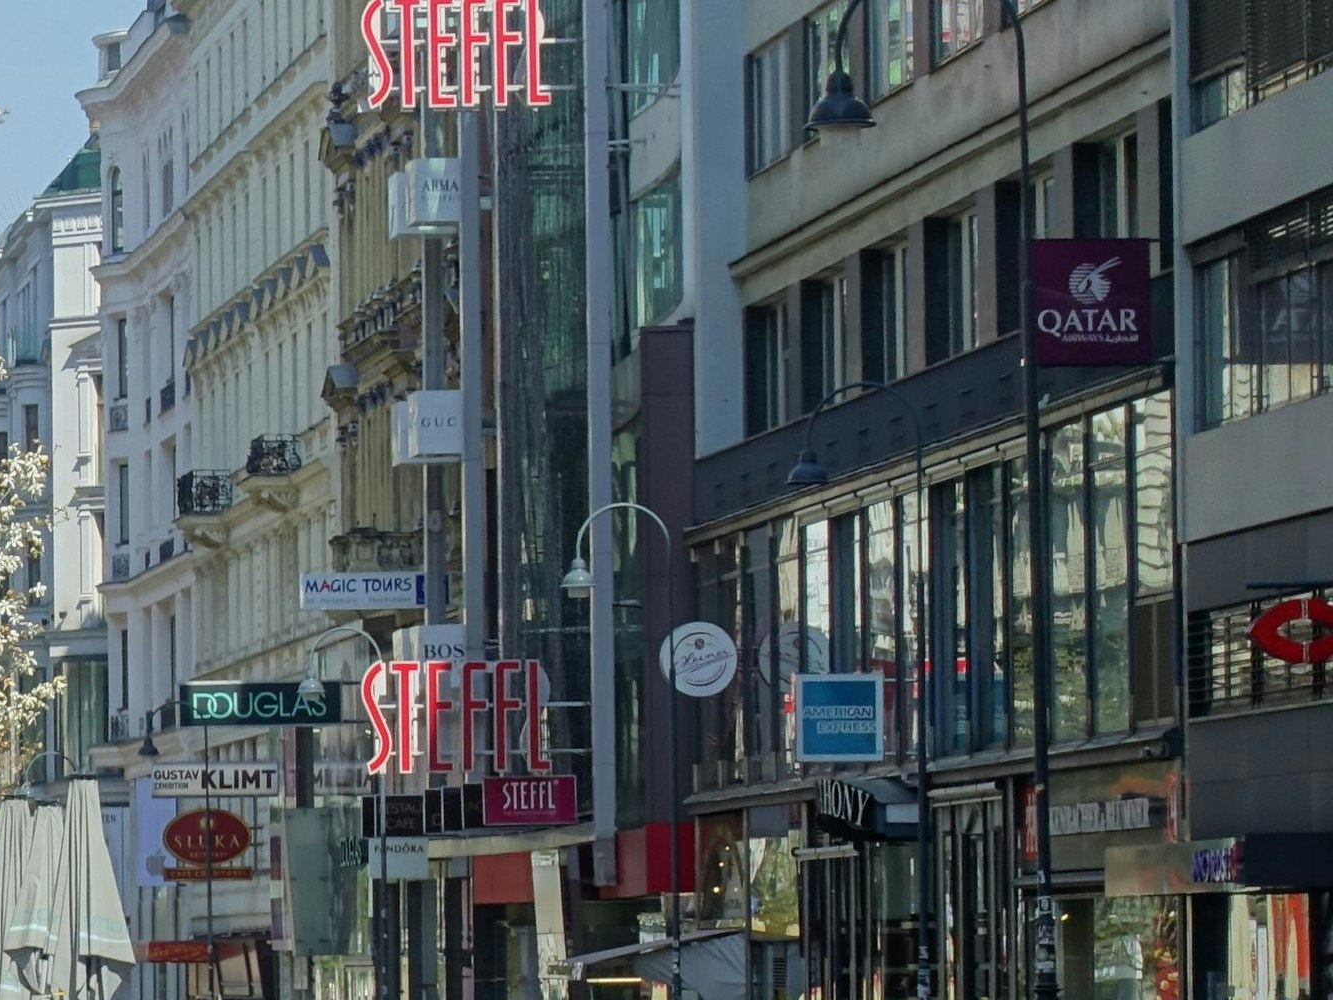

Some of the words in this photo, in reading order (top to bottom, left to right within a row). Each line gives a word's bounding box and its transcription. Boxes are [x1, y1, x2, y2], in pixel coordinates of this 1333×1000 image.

[361, 0, 551, 109] STEFFL
[421, 179, 459, 192] ARMA
[1037, 308, 1138, 338] QATAR
[421, 416, 457, 428] GUC
[305, 578, 357, 593] MAGIC
[362, 577, 412, 594] TOURS
[423, 643, 465, 659] BOS
[192, 691, 327, 719] DOUGLAS
[803, 705, 873, 719] AMERICAN
[361, 659, 553, 775] STEFFL
[817, 720, 877, 734] EXPRESS
[154, 769, 200, 781] GUSTAV
[201, 769, 276, 789] KLIMT
[502, 781, 556, 809] STEFFL
